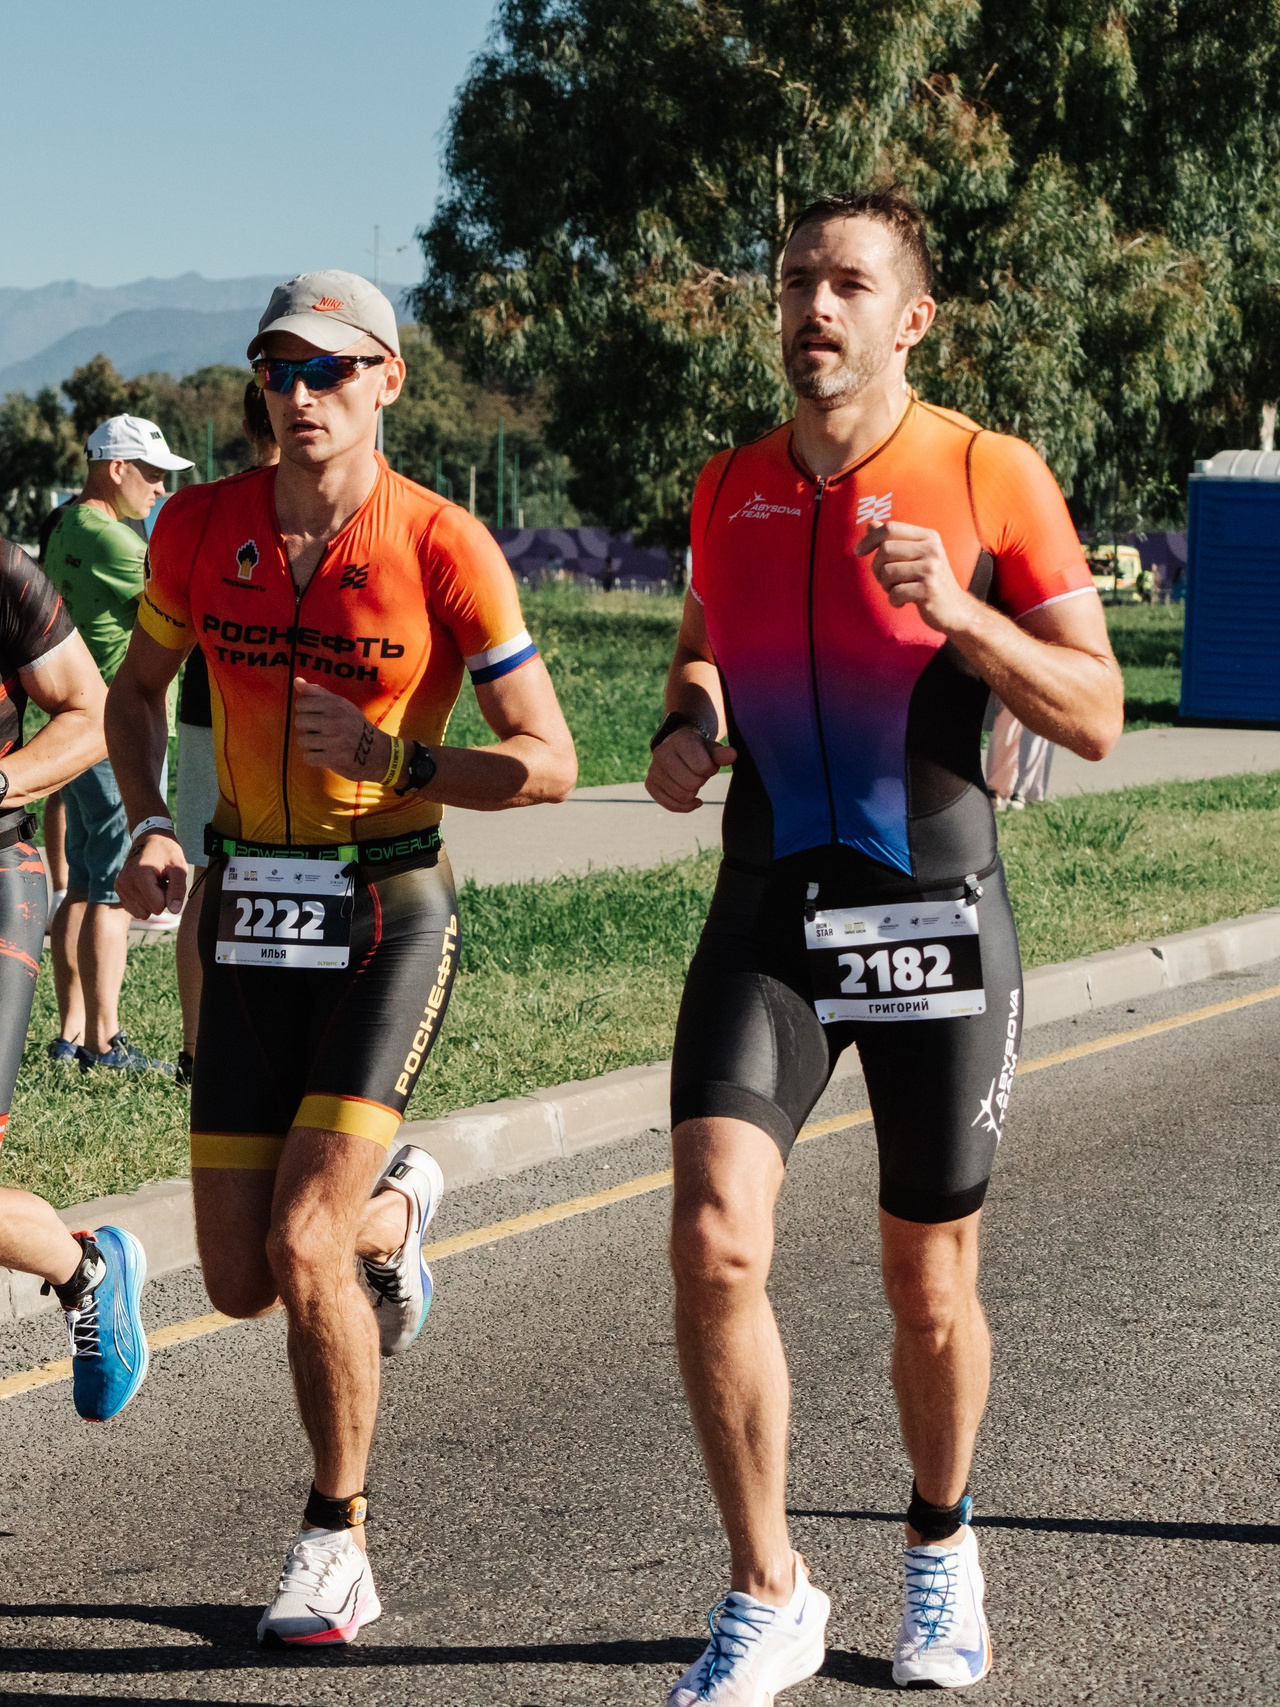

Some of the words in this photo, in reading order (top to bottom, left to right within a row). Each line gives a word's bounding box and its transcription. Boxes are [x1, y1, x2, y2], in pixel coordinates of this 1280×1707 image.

[319, 297, 345, 310] NIKE
[740, 510, 771, 520] TEAM
[750, 502, 802, 517] ABYSOVA
[202, 613, 405, 659] РОСНЕФТЬ
[214, 645, 379, 682] ТРИАТЛОН
[353, 722, 375, 766] 2222
[365, 832, 439, 861] OWERUP
[233, 897, 326, 940] 2222
[815, 922, 828, 930] IRON
[816, 928, 834, 938] STAR
[260, 948, 287, 959] ИЛЬЯ
[837, 944, 953, 994] 2182
[394, 914, 458, 1097] РОСНЕФТЬ
[868, 998, 929, 1014] ГРИГОРИЙ
[950, 1006, 974, 1015] OLYMPIC
[996, 988, 1020, 1109] ABYSOVA
